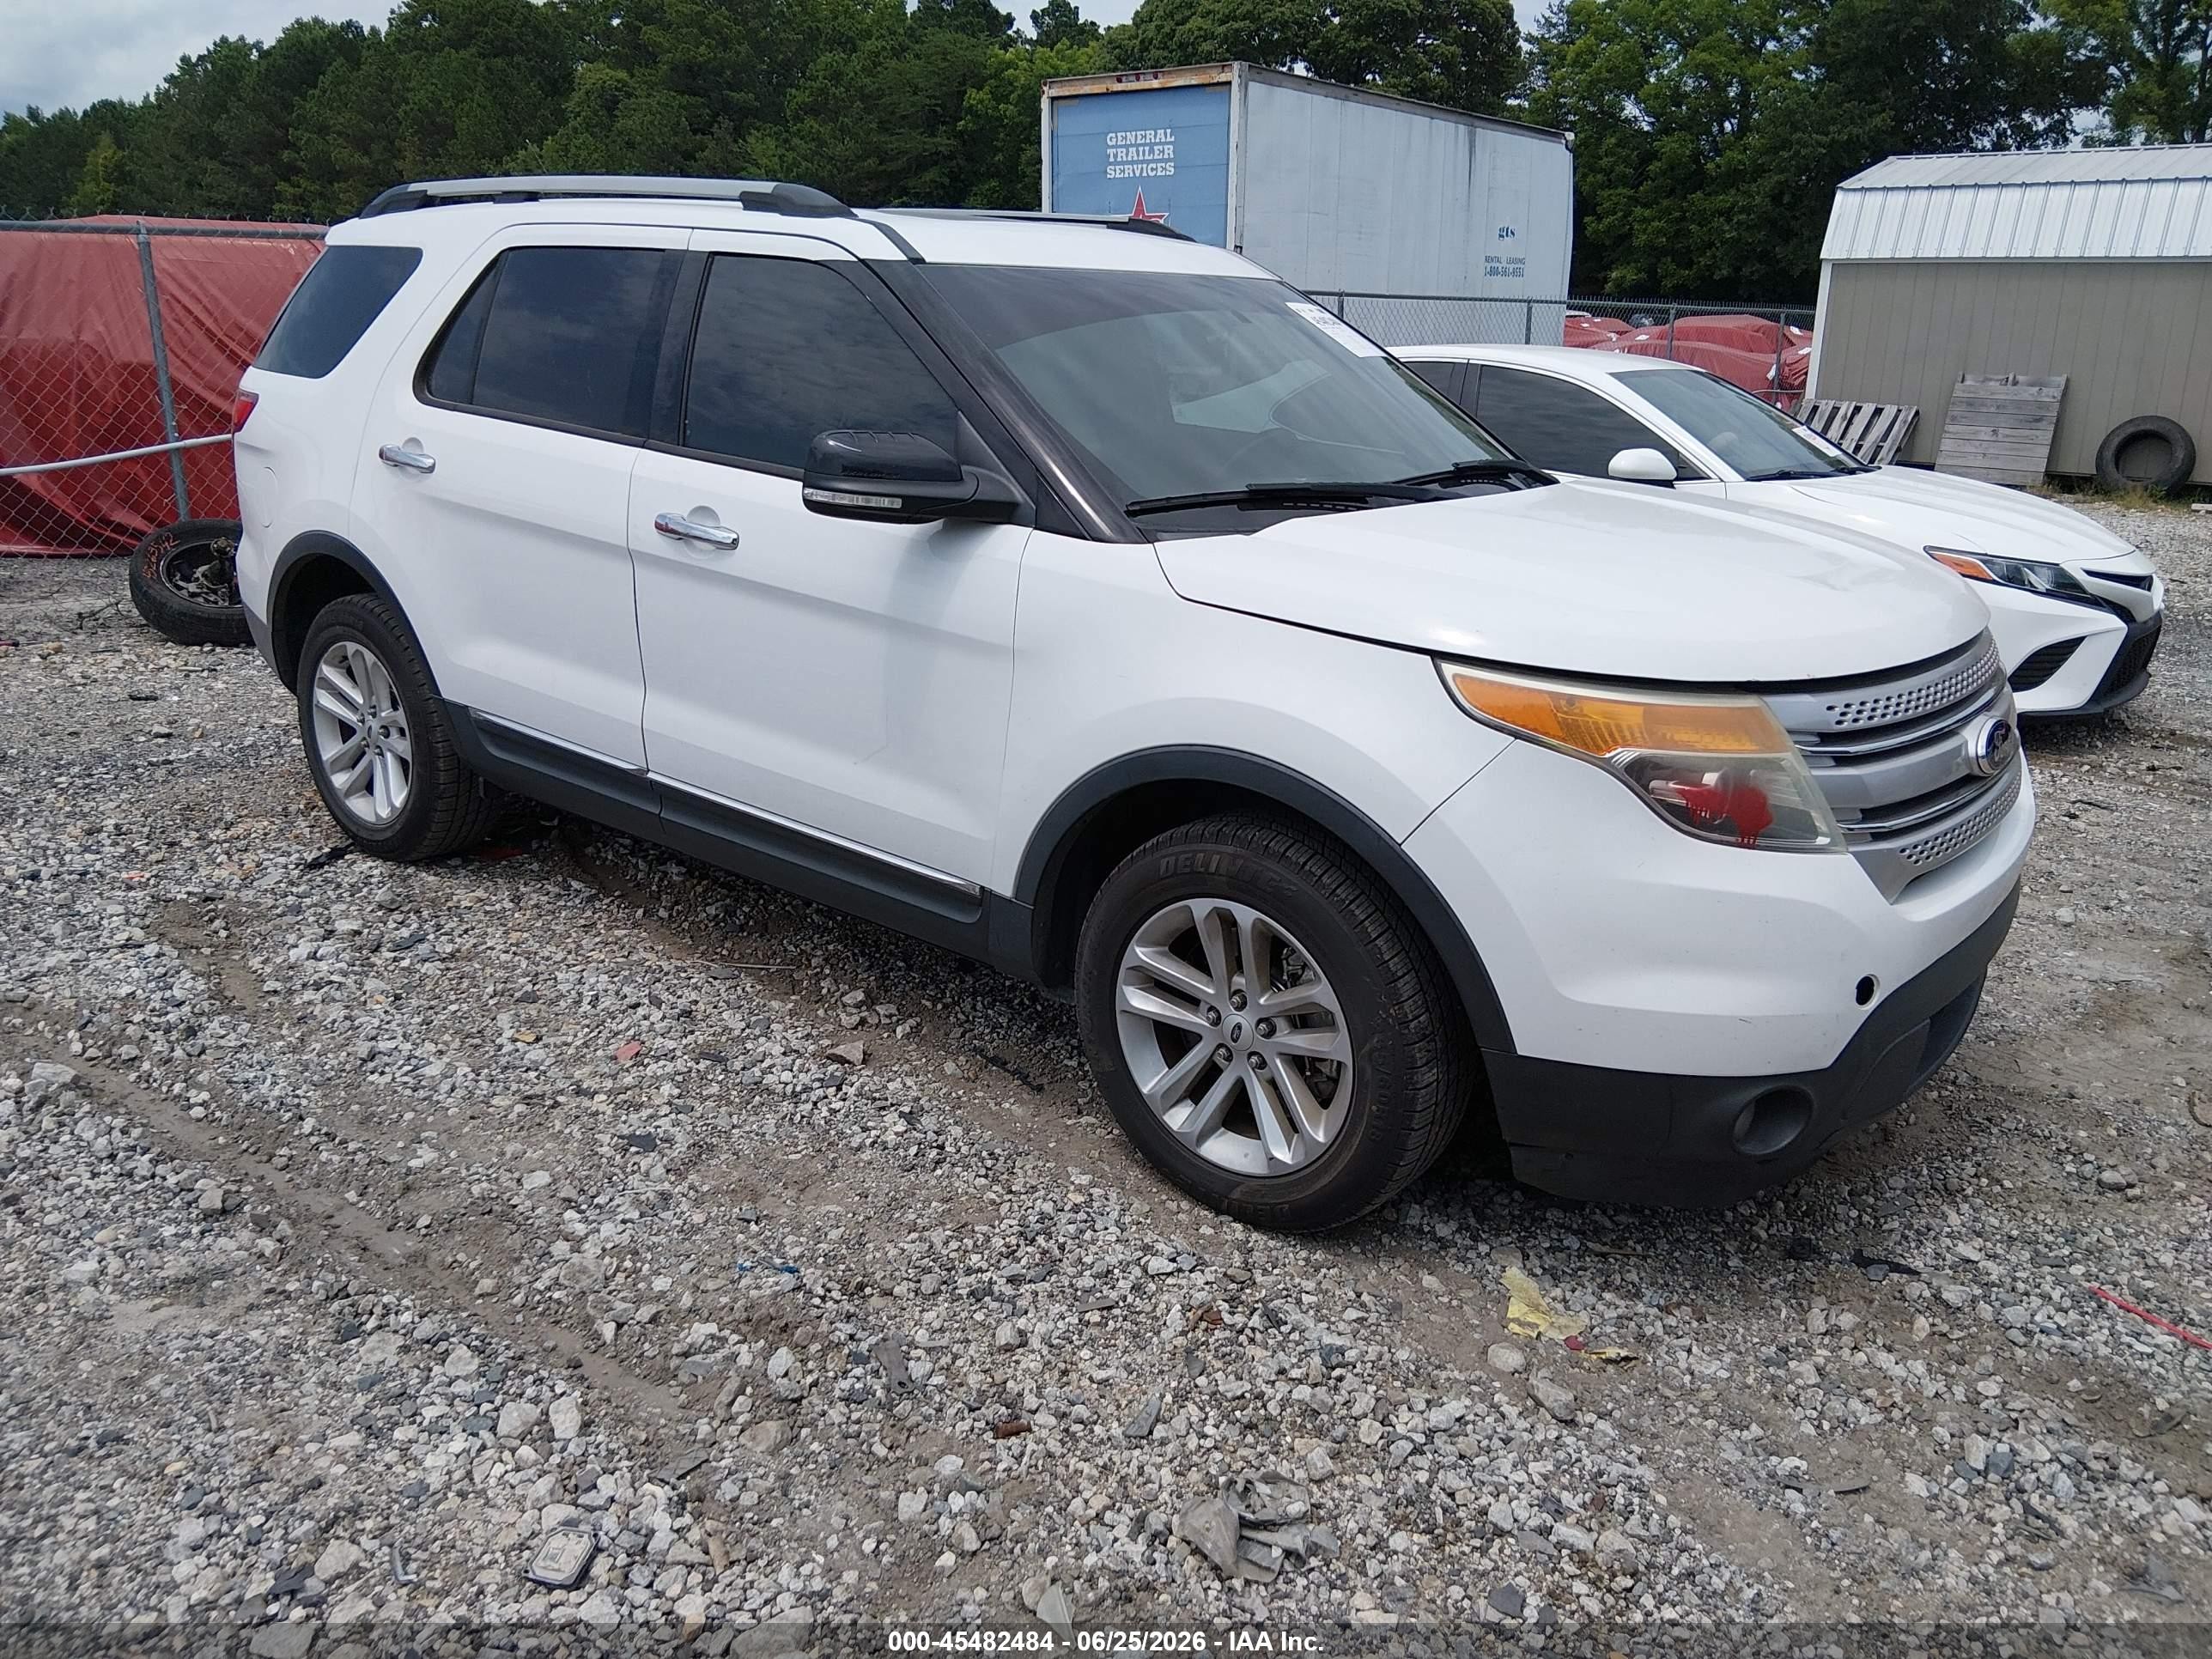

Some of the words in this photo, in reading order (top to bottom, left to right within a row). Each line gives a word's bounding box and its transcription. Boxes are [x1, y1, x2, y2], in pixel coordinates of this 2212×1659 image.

[1106, 128, 1175, 145] GENERAL
[1106, 144, 1175, 162] TRAILER
[1106, 161, 1175, 179] SERVICES
[1498, 226, 1516, 240] gts
[1485, 255, 1502, 264] RENTAL
[1506, 256, 1525, 264] LEASING
